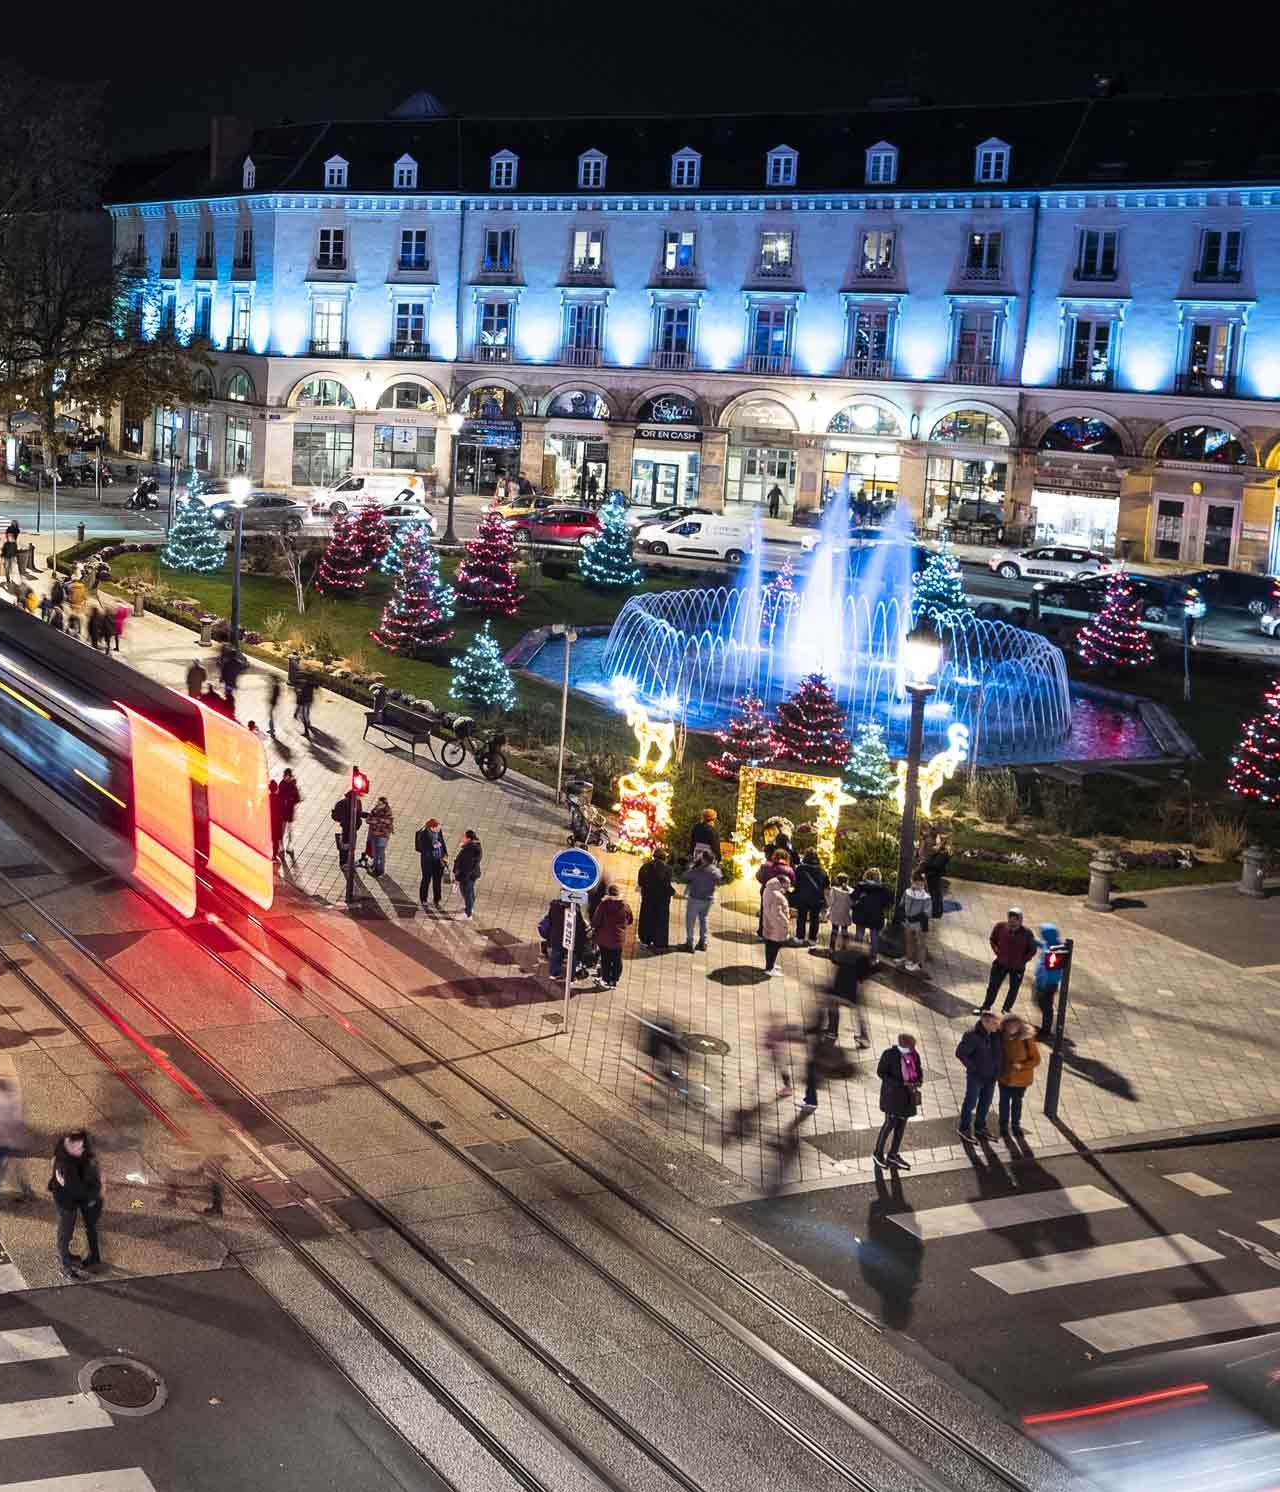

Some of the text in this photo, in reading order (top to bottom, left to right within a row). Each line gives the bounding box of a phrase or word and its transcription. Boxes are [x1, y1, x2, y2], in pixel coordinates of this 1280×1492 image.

[641, 430, 696, 440] OR EN CASH
